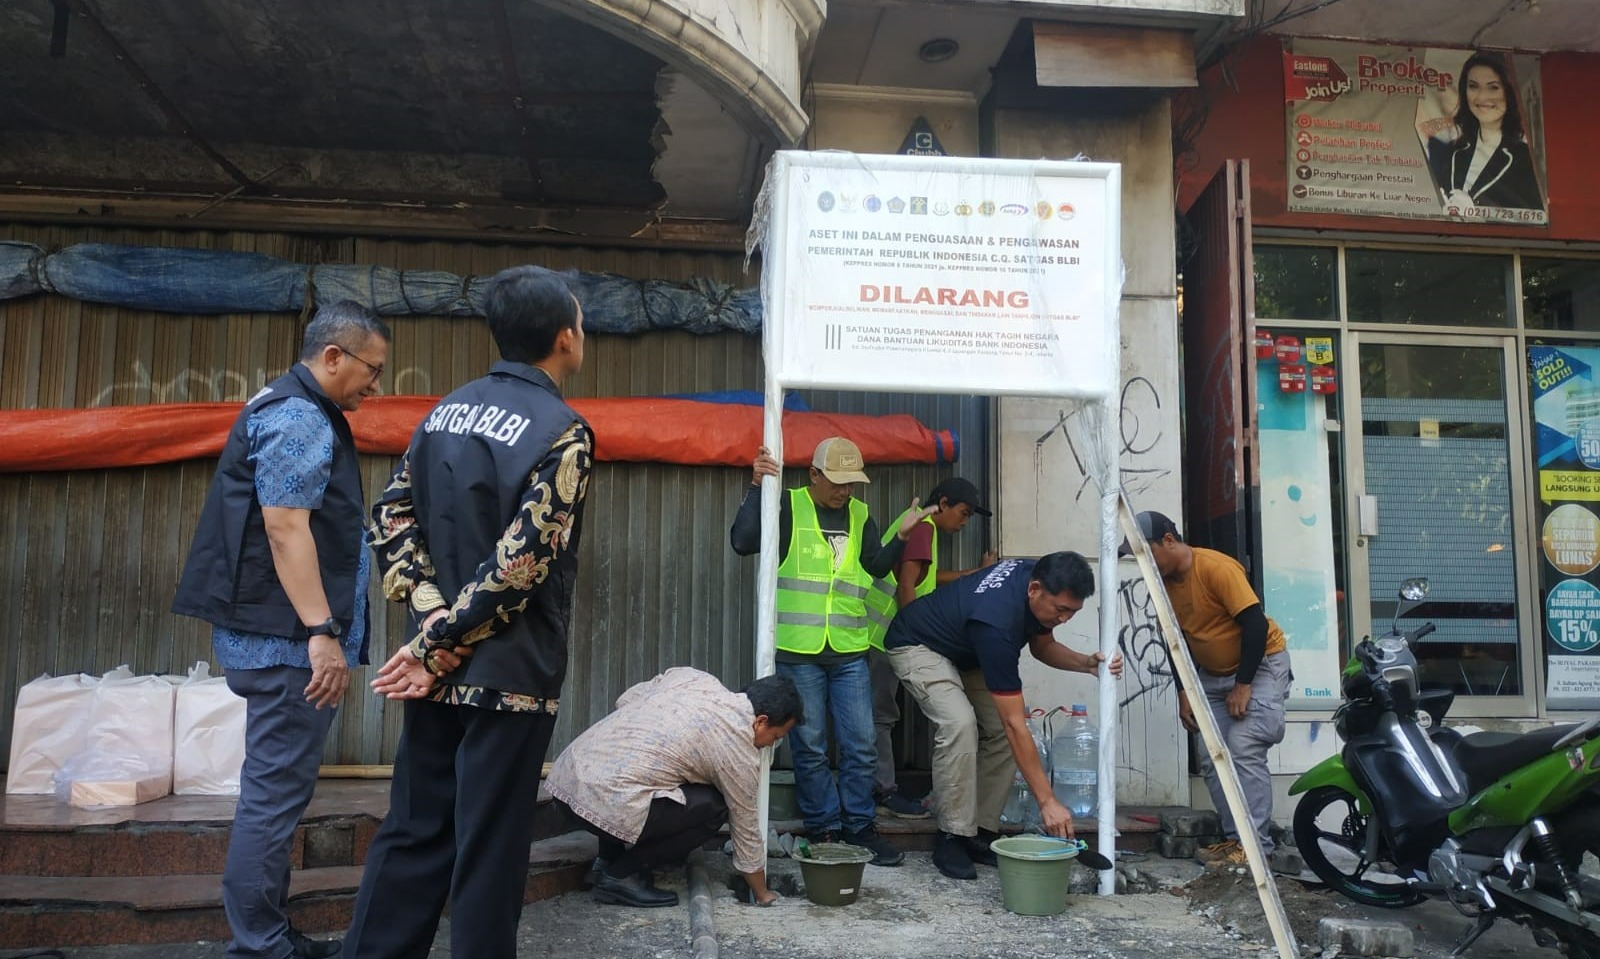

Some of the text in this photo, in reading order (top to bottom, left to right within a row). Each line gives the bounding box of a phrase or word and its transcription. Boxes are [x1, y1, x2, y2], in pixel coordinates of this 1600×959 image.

[1358, 54, 1453, 89] Broker
[1305, 76, 1351, 100] Join Us!
[1359, 78, 1424, 96] Properti
[1313, 168, 1413, 183] Penghargaan Prestasi
[1308, 187, 1333, 198] Bonus
[1337, 189, 1367, 199] Liburan
[1383, 192, 1402, 201] Luar
[1405, 193, 1432, 203] Negeri
[1463, 207, 1491, 218] (021)
[809, 229, 1080, 249] ASET INI DALAM PENGUASAAN & PENGAWASAN
[808, 246, 1080, 265] PEMERINTAH REPUBLIK INDONESIA C.Q. SATGAS BLBI
[859, 284, 1030, 309] DILARANG
[846, 326, 1060, 341] SATUAN TUGAS PENANGANAN HAK TAGIH NEGARA
[857, 335, 1048, 350] DANA BANTUAN LIKUIDITAS BANK INDONESIA
[1536, 358, 1565, 379] SOLD
[424, 402, 531, 447] SATGA BLBI
[1545, 484, 1592, 492] LANGSUNG
[1558, 619, 1598, 643] 15%
[1304, 687, 1332, 697] Bank
